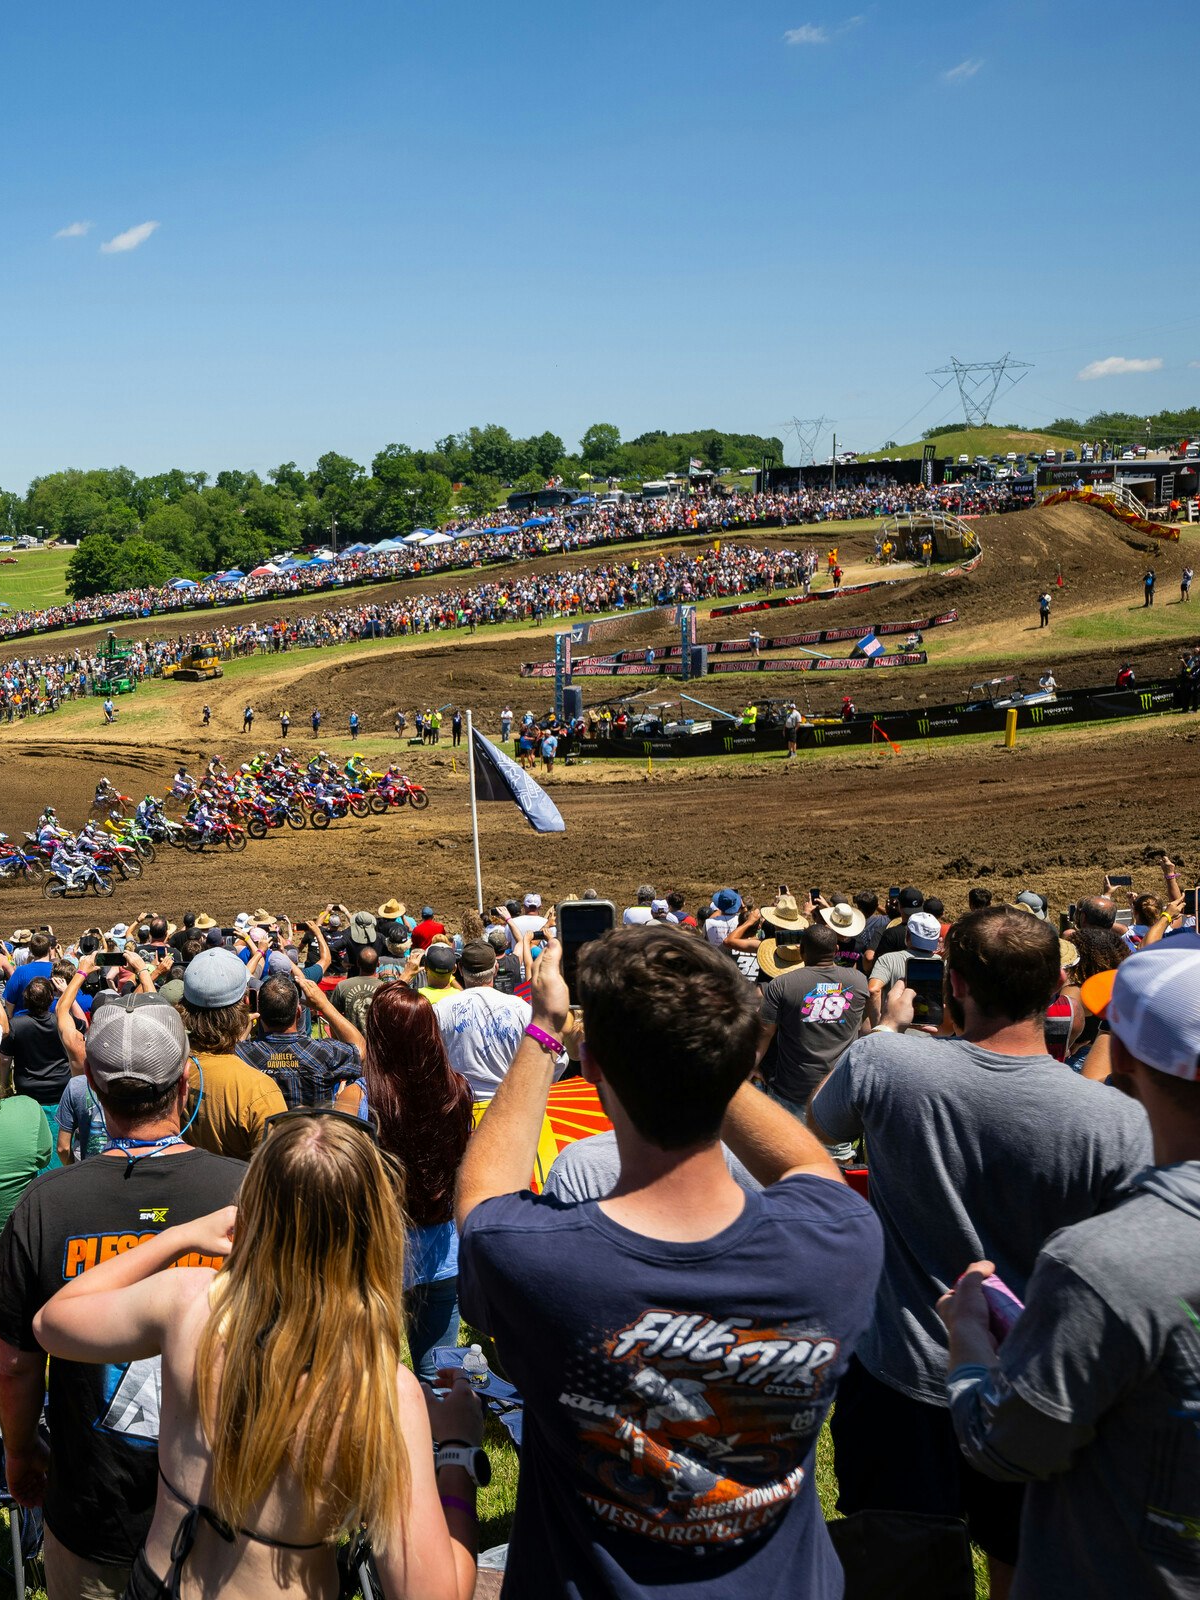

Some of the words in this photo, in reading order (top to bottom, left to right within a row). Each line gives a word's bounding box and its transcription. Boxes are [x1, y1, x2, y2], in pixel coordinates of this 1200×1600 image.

[809, 996, 847, 1020] 18
[267, 1061, 299, 1069] DAVIDSON
[139, 1209, 168, 1222] SMX
[611, 1311, 753, 1361] FIVE
[702, 1340, 837, 1385] STAR
[764, 1384, 814, 1397] CYCLE
[558, 1392, 616, 1418] KTM
